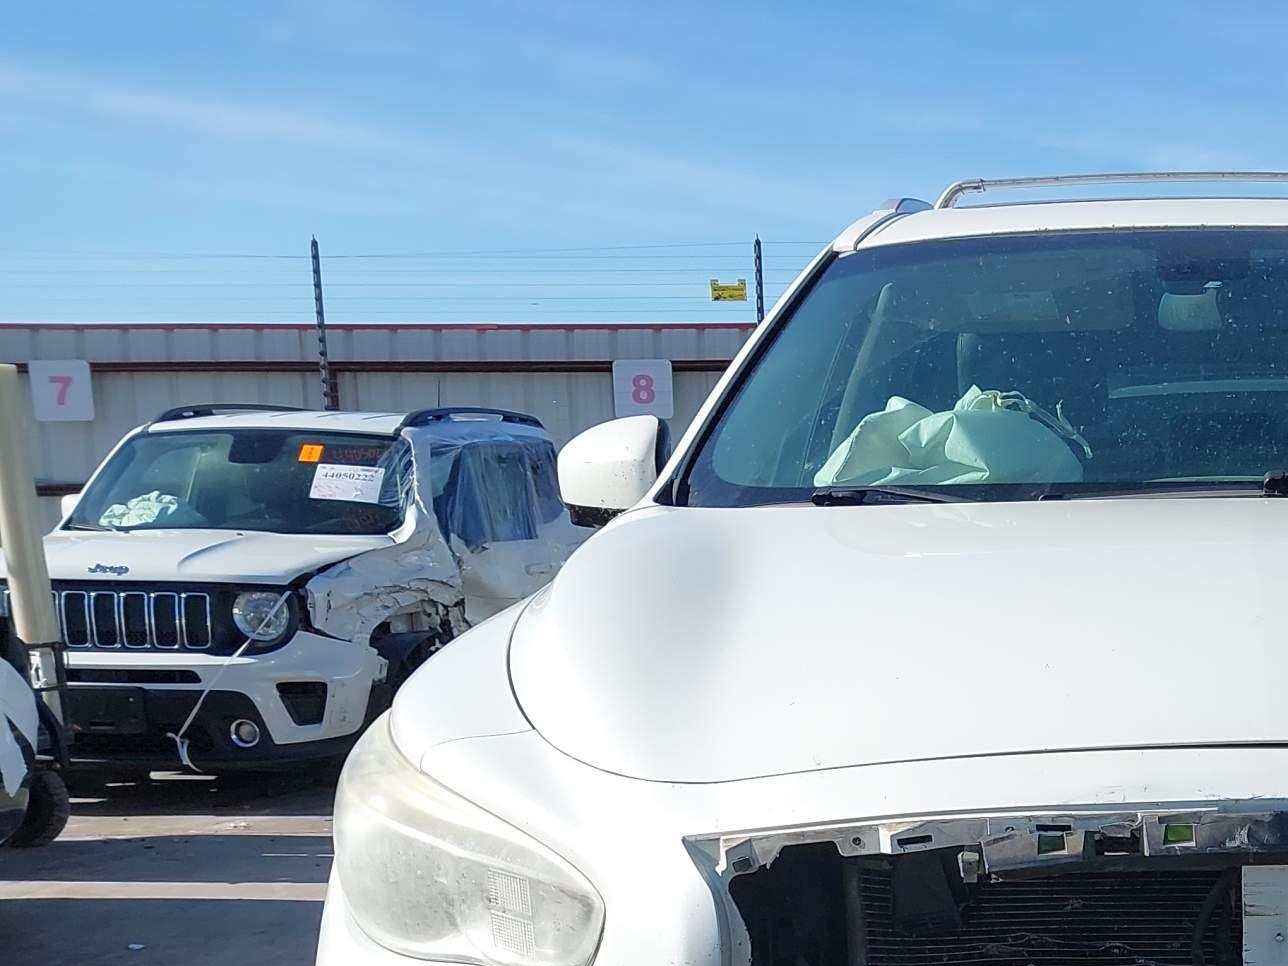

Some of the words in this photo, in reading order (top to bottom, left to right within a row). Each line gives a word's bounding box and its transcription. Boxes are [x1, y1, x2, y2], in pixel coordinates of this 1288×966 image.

[48, 375, 73, 406] 7
[631, 374, 656, 405] 8
[87, 563, 127, 576] Jeep
